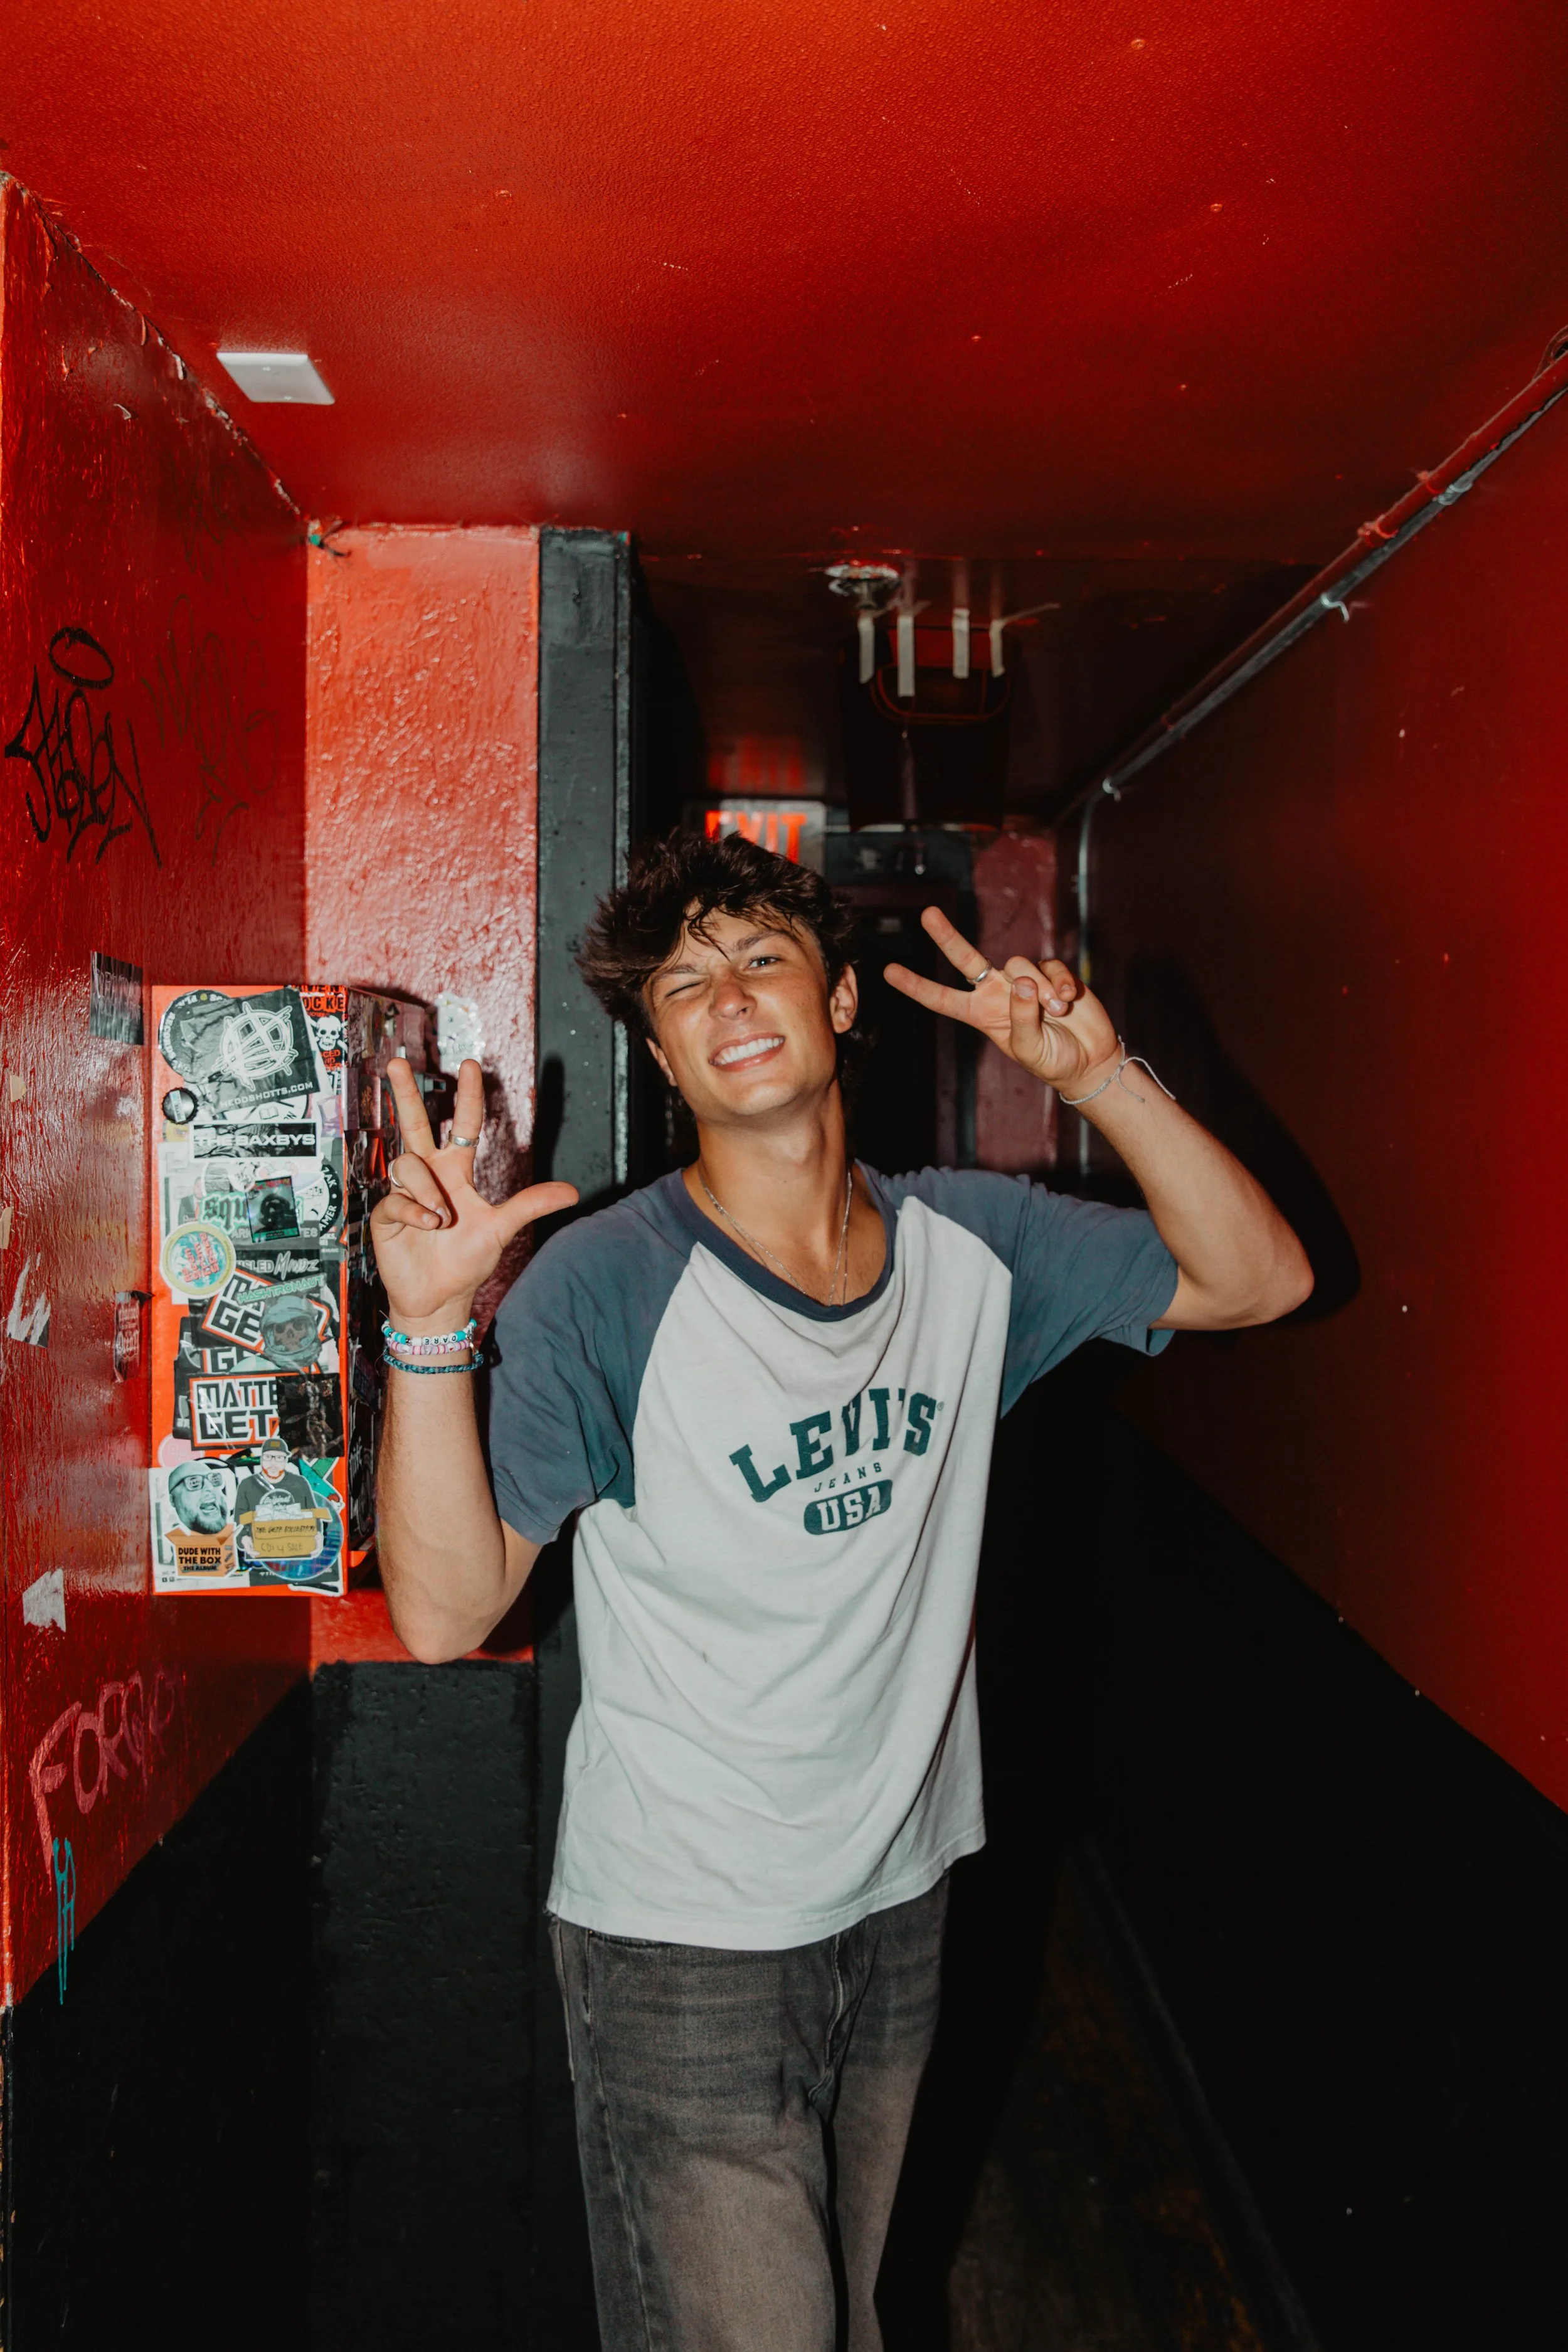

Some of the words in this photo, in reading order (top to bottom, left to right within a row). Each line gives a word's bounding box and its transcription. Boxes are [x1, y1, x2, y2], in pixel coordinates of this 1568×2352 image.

[236, 1133, 315, 1147] BAXBYS
[729, 1387, 936, 1503] LEVI'S
[814, 1461, 882, 1493] JEANS
[817, 1485, 882, 1532] USA
